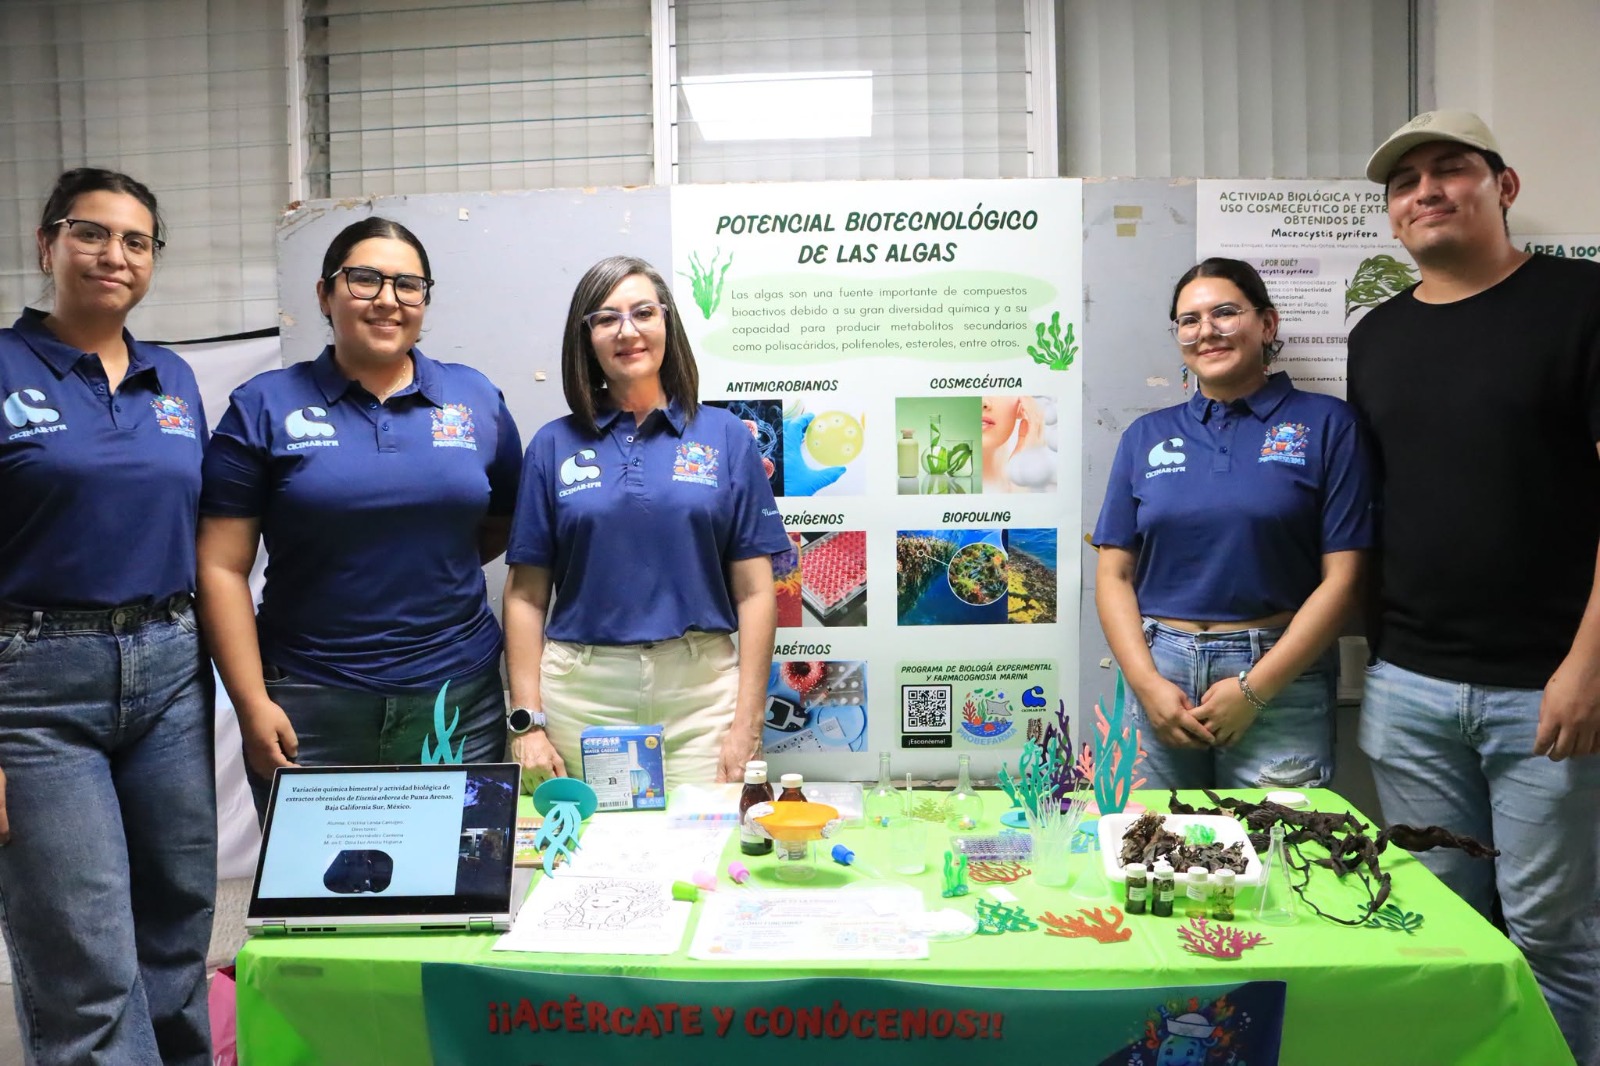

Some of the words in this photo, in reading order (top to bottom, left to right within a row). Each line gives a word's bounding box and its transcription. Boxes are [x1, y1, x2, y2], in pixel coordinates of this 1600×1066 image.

[1219, 191, 1284, 202] ACTIVIDAD
[1288, 190, 1350, 202] BIOLÓGICA
[1354, 193, 1361, 202] Y
[1365, 193, 1386, 202] POT
[1220, 204, 1243, 213] USO
[1343, 204, 1356, 214] DE
[1360, 204, 1388, 214] EXTR
[715, 213, 836, 234] POTENCIAL
[845, 202, 1038, 232] BIOTECNOLÓGICO
[1284, 215, 1348, 225] OBTENIDOS
[1352, 216, 1366, 225] DE
[1271, 228, 1334, 240] Macrocystis
[1336, 230, 1378, 240] pyrifera
[797, 244, 829, 264] DE
[836, 243, 878, 264] LAS
[885, 242, 958, 262] ALGAS
[1280, 258, 1298, 266] QUÉ?
[1256, 268, 1284, 276] rocystis
[731, 290, 748, 300] Las
[754, 288, 784, 302] algas
[789, 290, 807, 298] son
[814, 290, 833, 298] una
[839, 287, 873, 298] fuente
[879, 286, 938, 300] importante
[944, 286, 957, 296] de
[963, 286, 1027, 298] compuestos
[732, 306, 786, 317] bioactivos
[790, 306, 828, 316] debido
[844, 307, 856, 315] su
[859, 306, 884, 318] gran
[888, 304, 943, 314] diversidad
[994, 306, 1000, 316] y
[1004, 305, 1011, 313] a
[1015, 305, 1027, 313] su
[732, 322, 790, 336] capacidad
[800, 324, 826, 335] para
[836, 322, 880, 334] producir
[890, 321, 954, 331] metabolitos
[963, 320, 1028, 330] secundarios
[732, 343, 762, 351] como
[765, 339, 838, 353] polisacáridos,
[842, 338, 902, 352] polifenoles,
[905, 338, 956, 349] esteroles,
[959, 339, 987, 348] entre
[990, 339, 1020, 348] otros.
[1288, 336, 1310, 344] METAS
[1312, 336, 1324, 344] DEL
[1326, 336, 1348, 344] ESTUD
[726, 380, 839, 393] ANTIMICROBIANOS
[930, 374, 1022, 390] COSMECÉUTICA
[780, 510, 844, 525] ERÍGENOS
[942, 510, 1011, 524] BIOFOULING
[774, 640, 832, 655] ABÉTICOS
[901, 666, 943, 674] PROGRAMA
[946, 665, 956, 673] DE
[959, 662, 993, 672] BIOLOGÍA
[996, 663, 1052, 672] EXPERIMENTAL
[926, 674, 931, 682] Y
[934, 673, 997, 681] FARMACOGNOSIA
[1000, 673, 1028, 681] MARINA
[956, 727, 1018, 746] PROBEFARMA
[488, 994, 703, 1038] ¡¡ACÉRCATE
[712, 1006, 735, 1037] Y
[744, 998, 1005, 1040] CONÓCENOS!!
